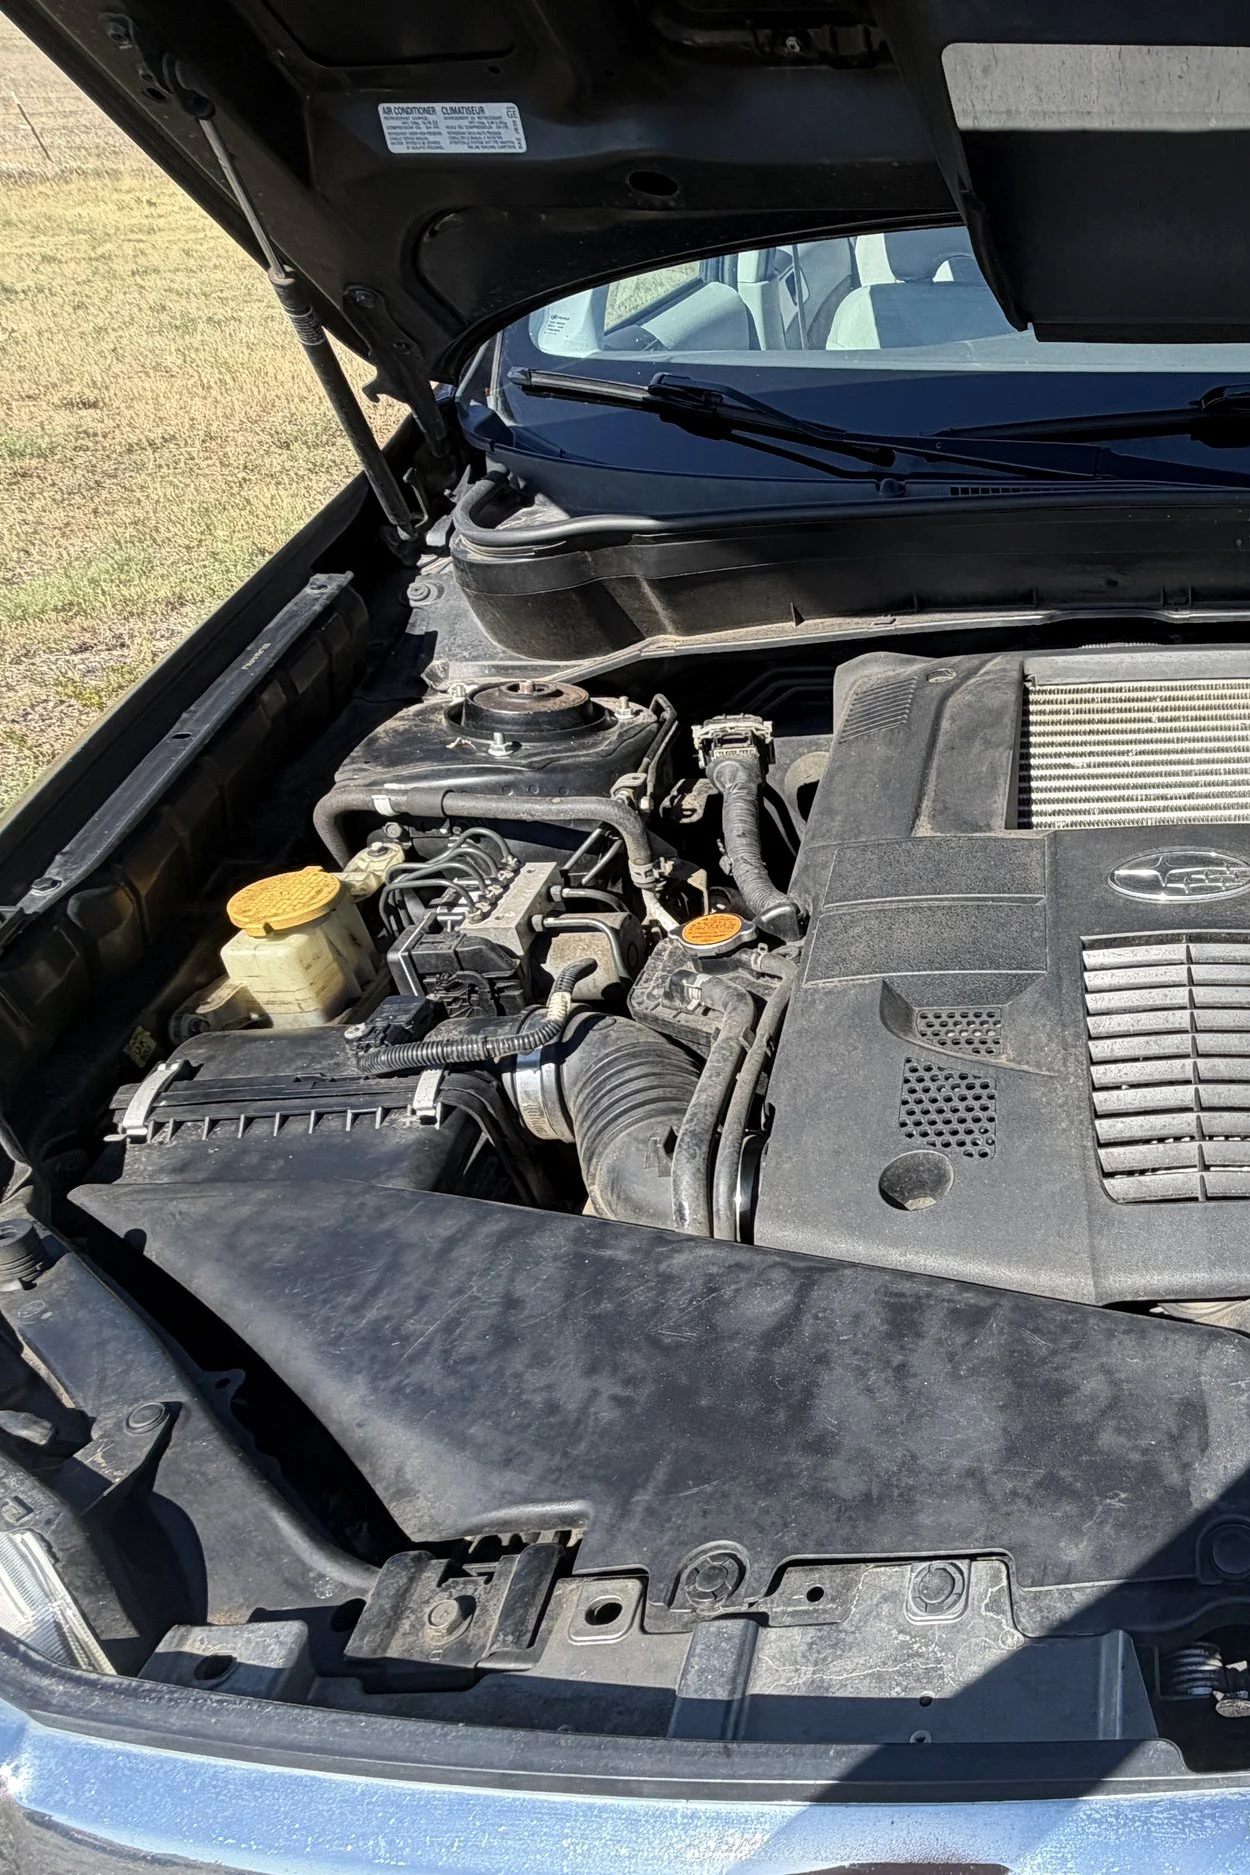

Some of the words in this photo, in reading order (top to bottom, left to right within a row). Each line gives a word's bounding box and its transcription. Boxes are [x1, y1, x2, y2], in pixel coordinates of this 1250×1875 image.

[383, 107, 393, 115] AIR
[394, 107, 436, 115] CONDITIONER
[441, 106, 485, 115] CLIMATISEUR
